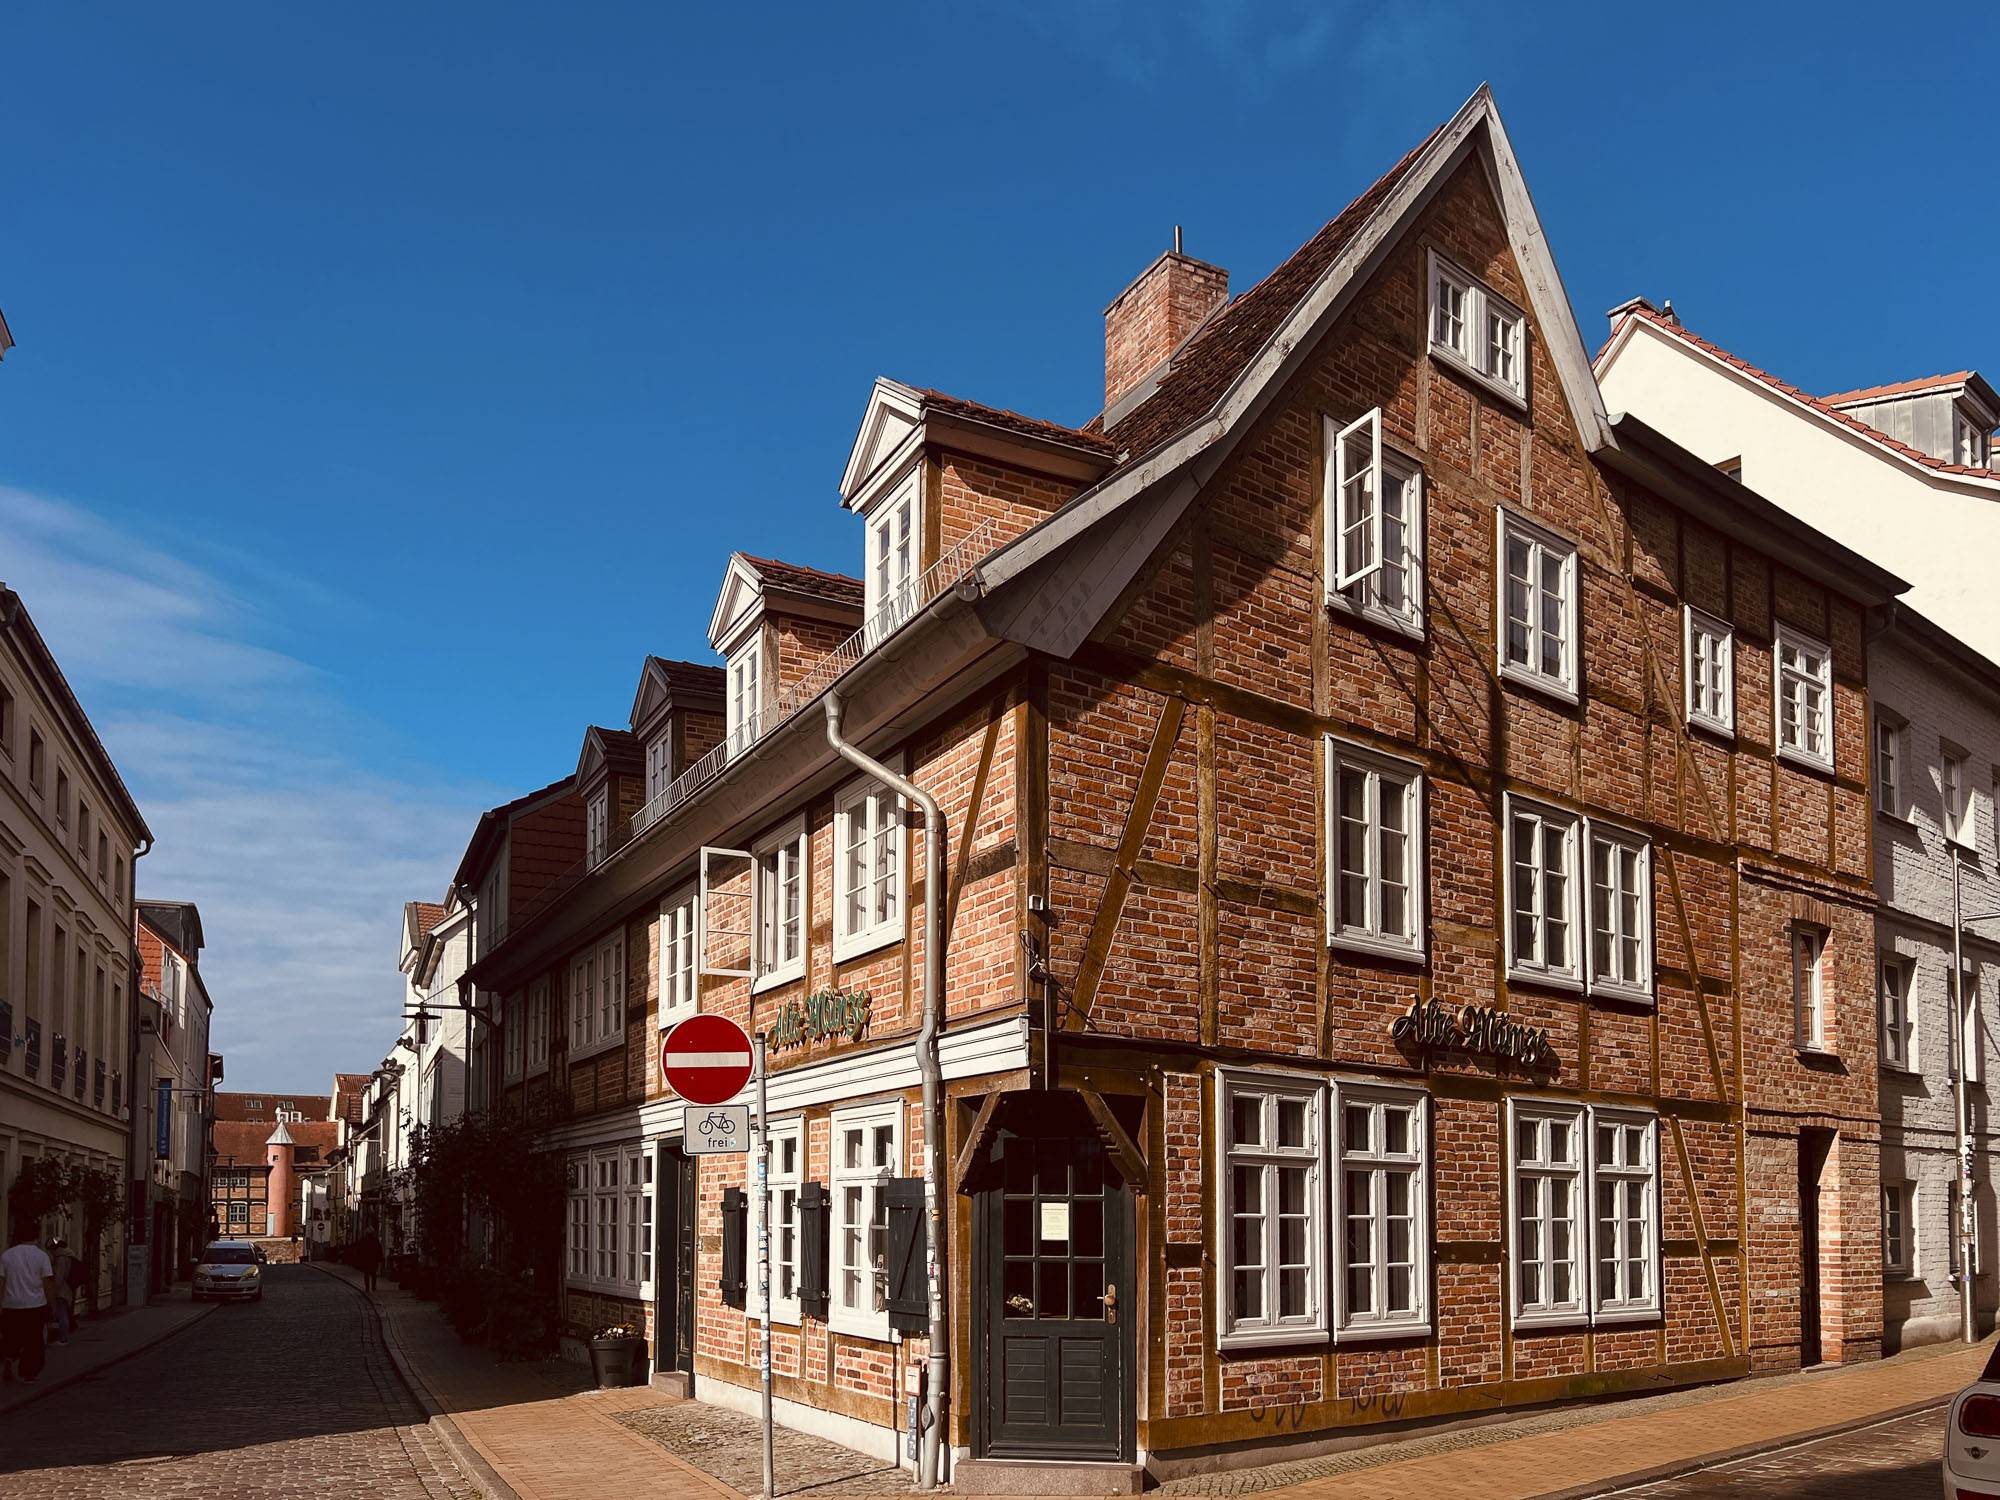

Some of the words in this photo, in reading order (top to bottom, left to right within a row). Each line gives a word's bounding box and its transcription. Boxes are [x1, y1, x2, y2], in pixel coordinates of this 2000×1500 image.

[768, 998, 803, 1048] Alte
[1389, 994, 1457, 1046] Alte
[1458, 1006, 1551, 1067] Münze
[708, 1137, 728, 1148] frei
